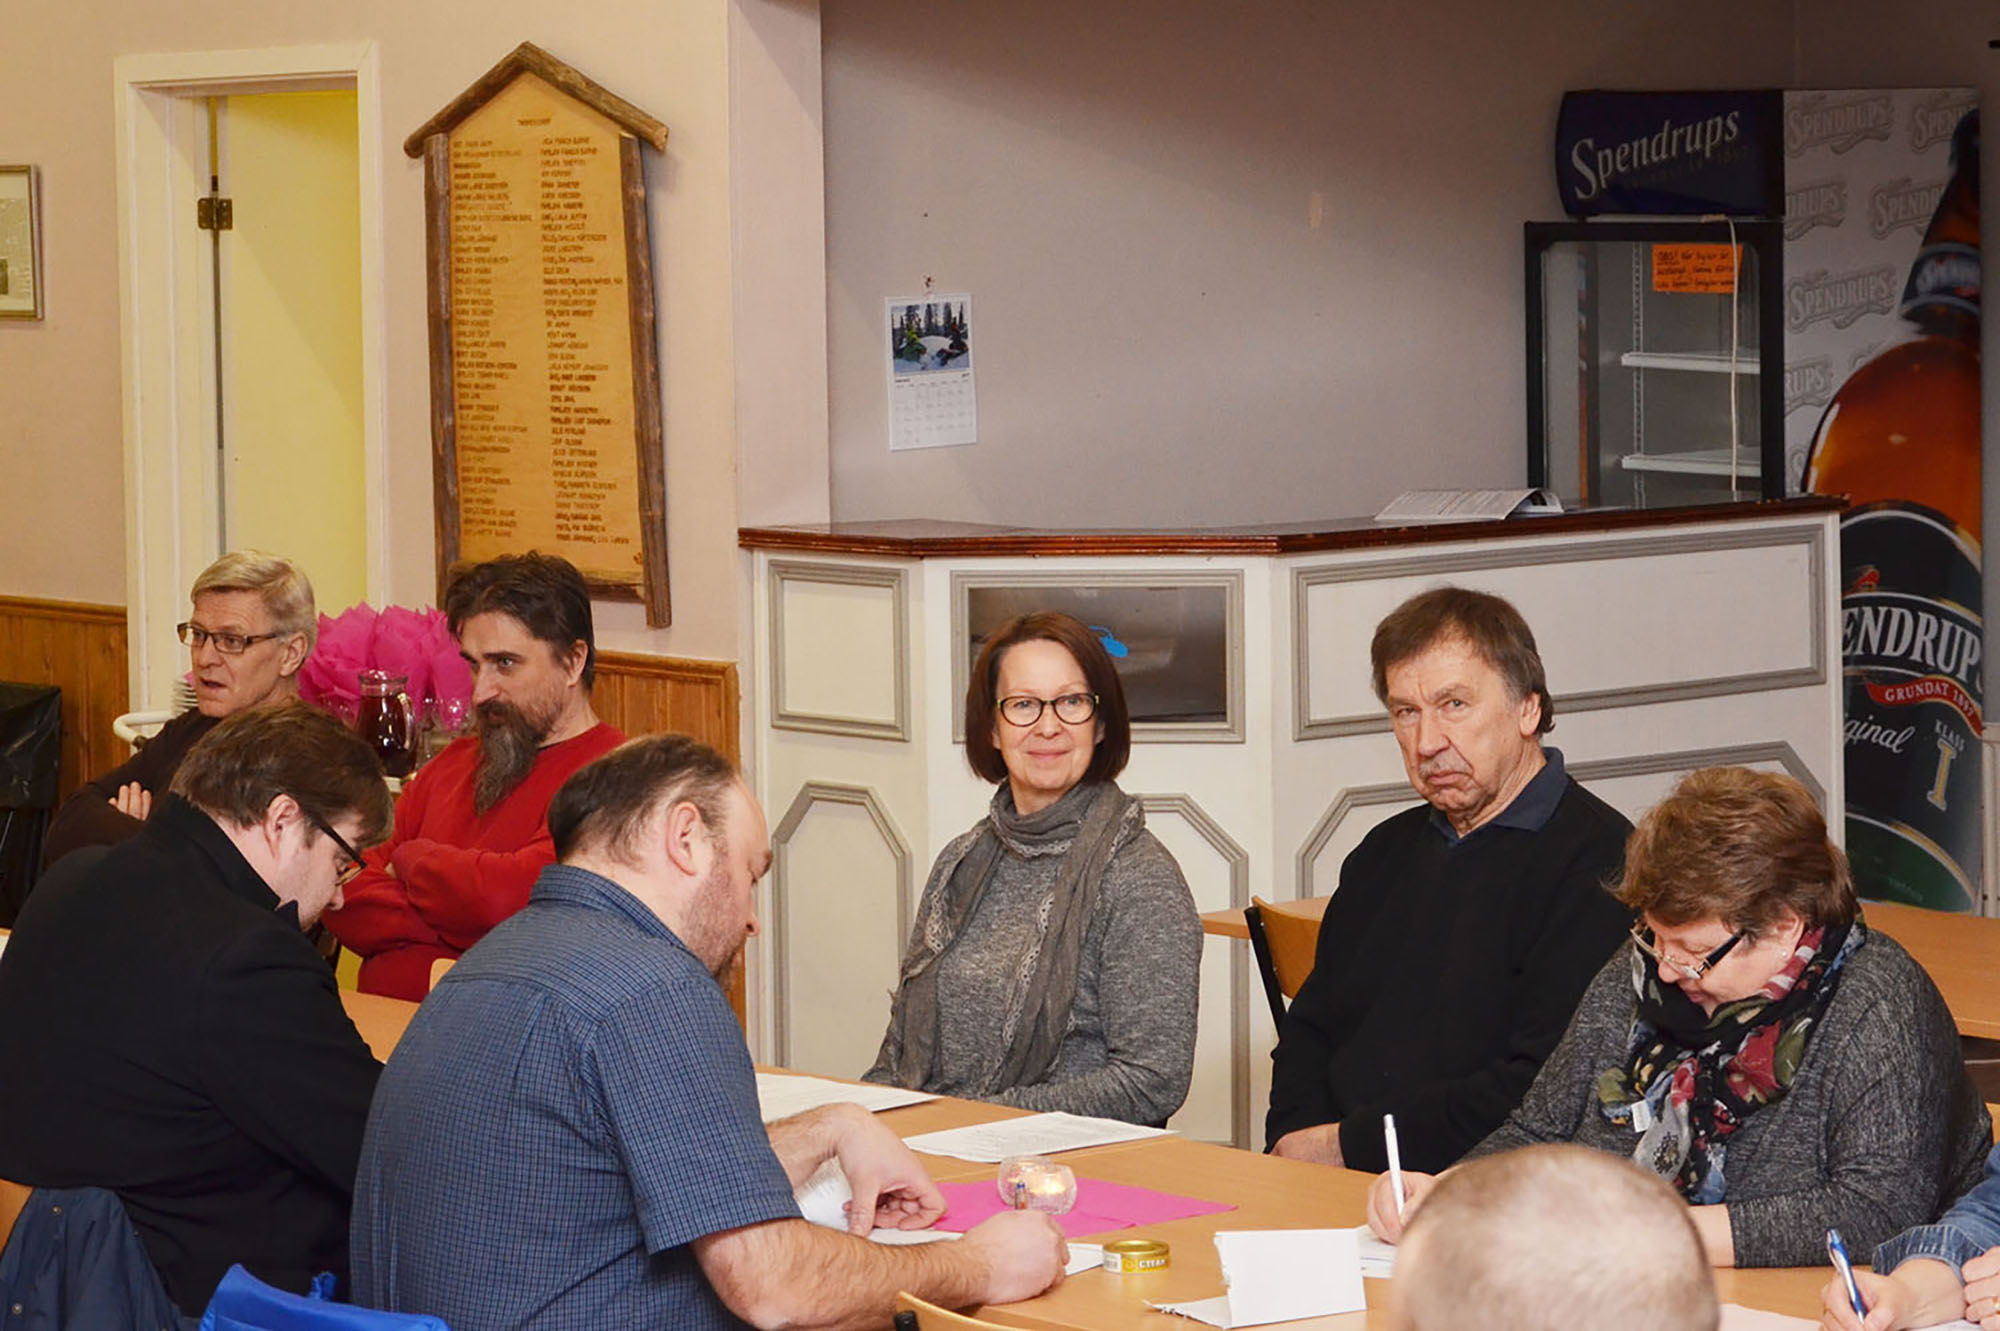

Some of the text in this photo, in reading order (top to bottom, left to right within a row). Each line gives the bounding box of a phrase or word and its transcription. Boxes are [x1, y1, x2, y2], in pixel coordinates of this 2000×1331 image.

[1571, 110, 1740, 199] Spendrups
[1790, 272, 1889, 323] SPENDRUPS
[1842, 605, 1982, 694] ENDRUP
[1885, 681, 1950, 701] GRUNDAT
[1843, 713, 1916, 754] ginal
